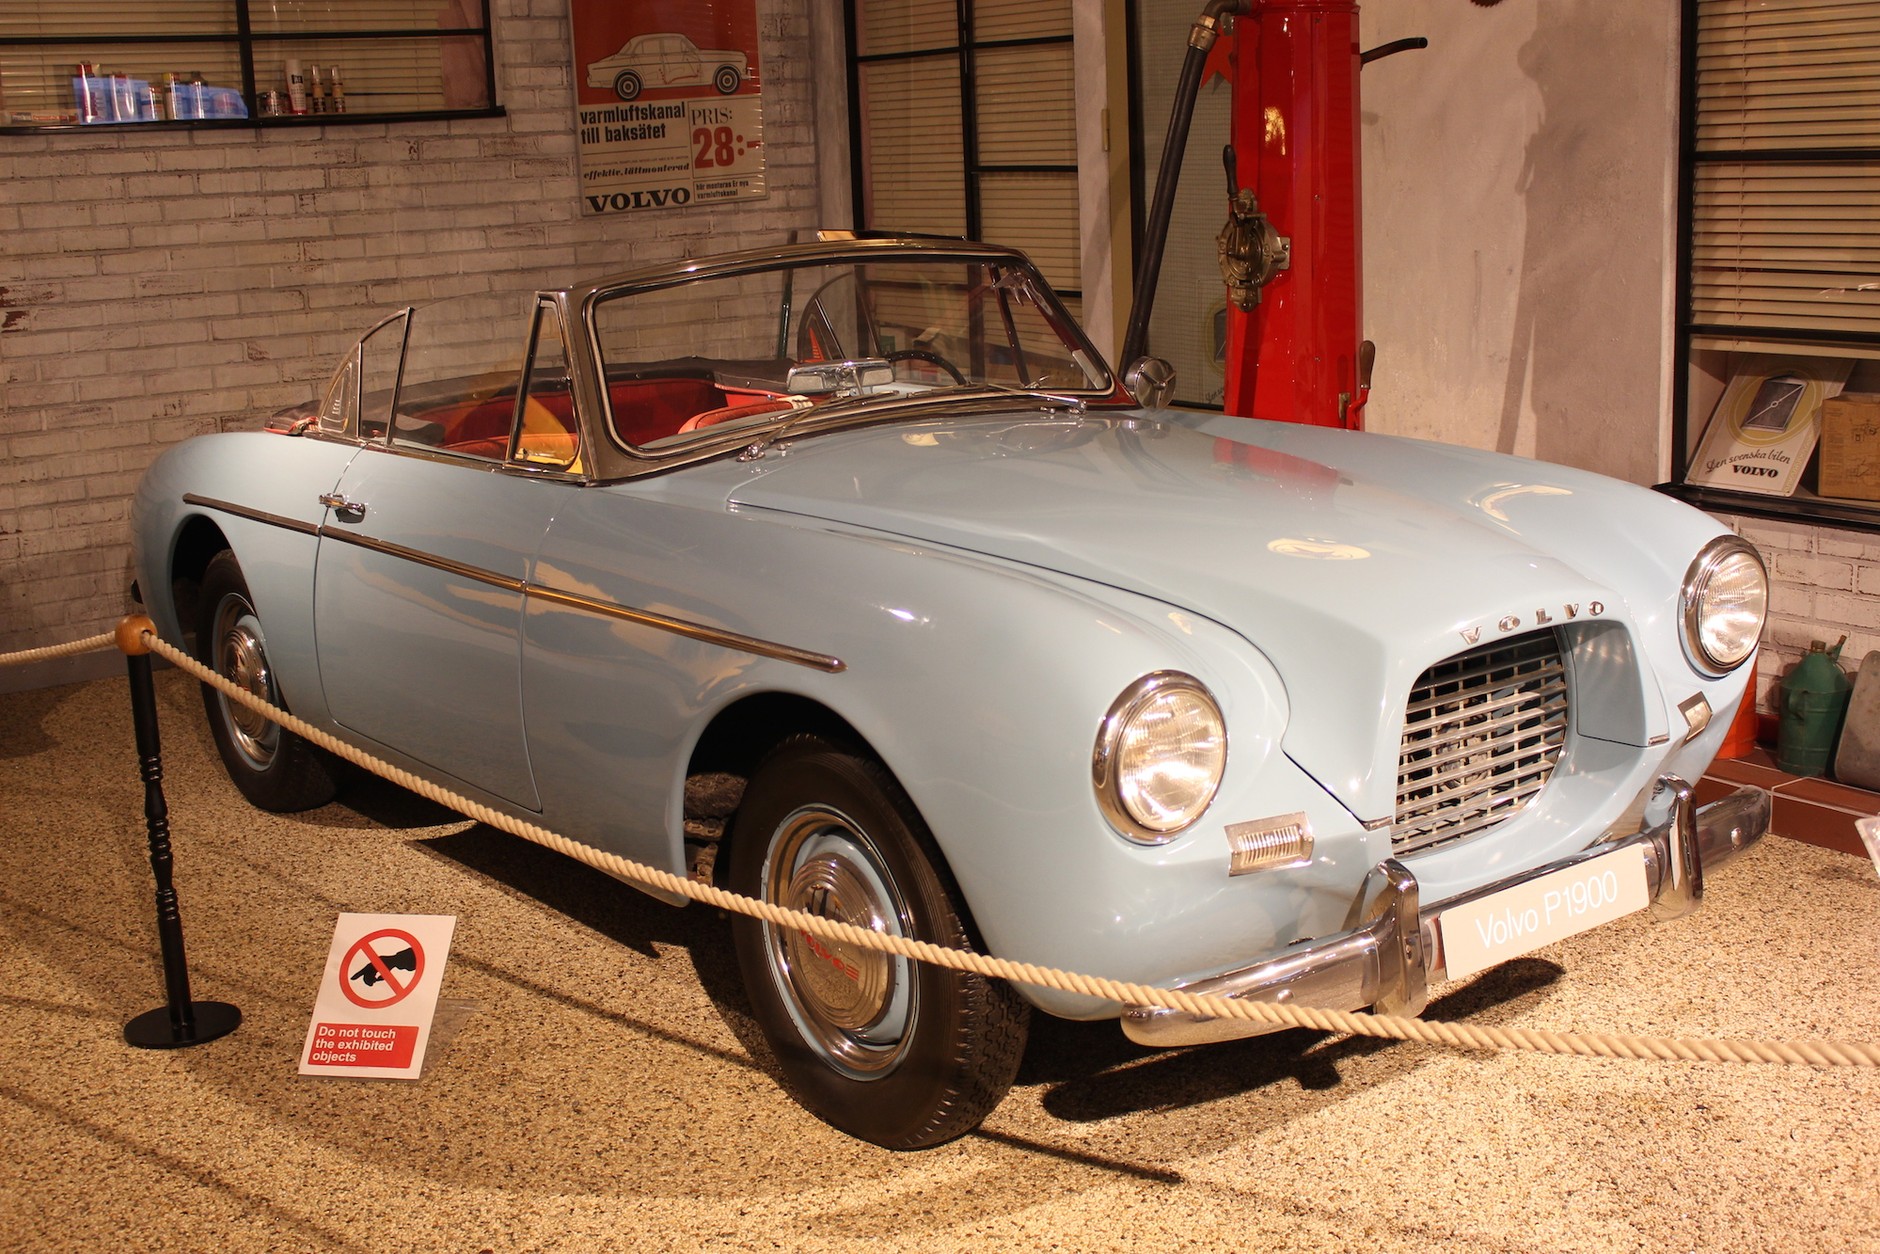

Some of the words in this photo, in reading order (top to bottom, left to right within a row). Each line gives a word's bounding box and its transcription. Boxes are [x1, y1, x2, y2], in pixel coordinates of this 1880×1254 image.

[580, 101, 685, 125] varmluftskanal
[691, 107, 733, 126] PRIS:
[581, 127, 600, 145] till
[605, 122, 666, 143] baksätet
[585, 187, 691, 213] VOLVO
[1706, 457, 1727, 473] Den
[1728, 449, 1766, 463] svenska
[1767, 449, 1791, 464] bilen
[1732, 464, 1779, 478] VOLVO
[1458, 600, 1605, 646] VOLVO
[1475, 912, 1539, 950] Volvo
[1543, 869, 1619, 927] P1900
[318, 1026, 336, 1037] Do
[339, 1027, 359, 1038] not
[361, 1027, 396, 1039] touch
[315, 1039, 335, 1049] the
[337, 1039, 394, 1051] exhibited
[312, 1051, 357, 1064] objects
